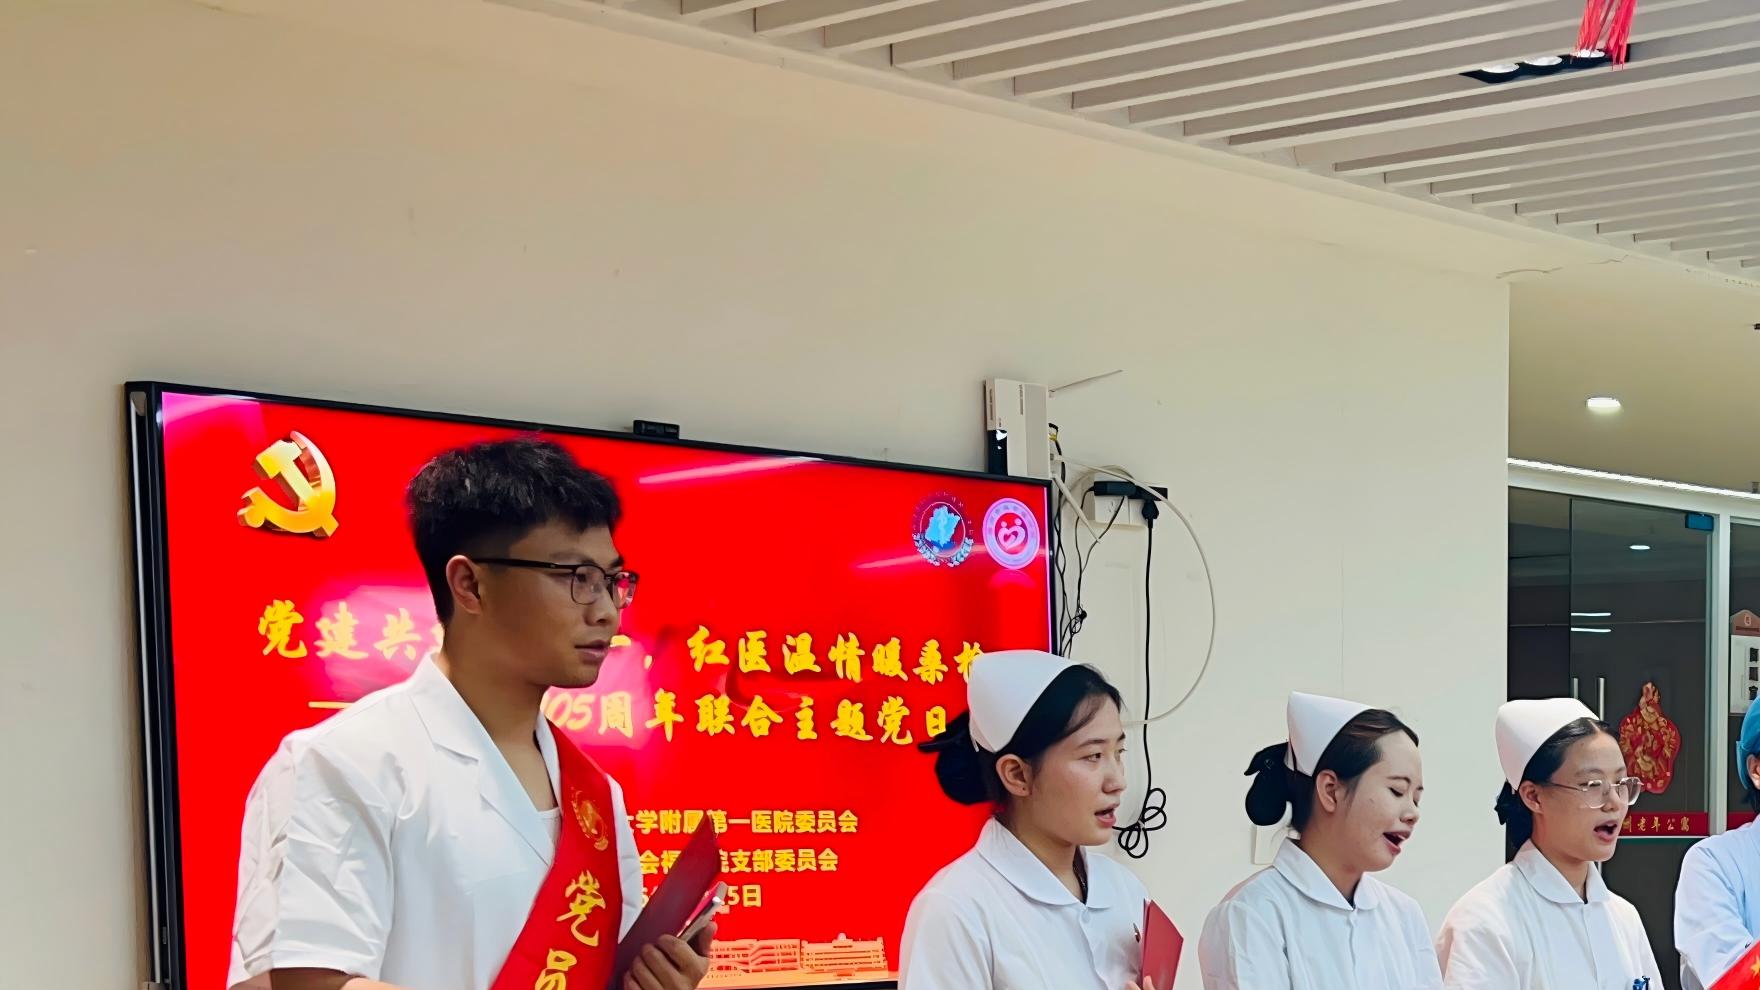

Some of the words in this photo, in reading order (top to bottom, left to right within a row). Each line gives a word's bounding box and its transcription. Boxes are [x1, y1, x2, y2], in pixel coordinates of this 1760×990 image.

[257, 599, 444, 659] 党建共
[541, 688, 947, 744] 05周年联合主题党日
[721, 884, 762, 908] 5日
